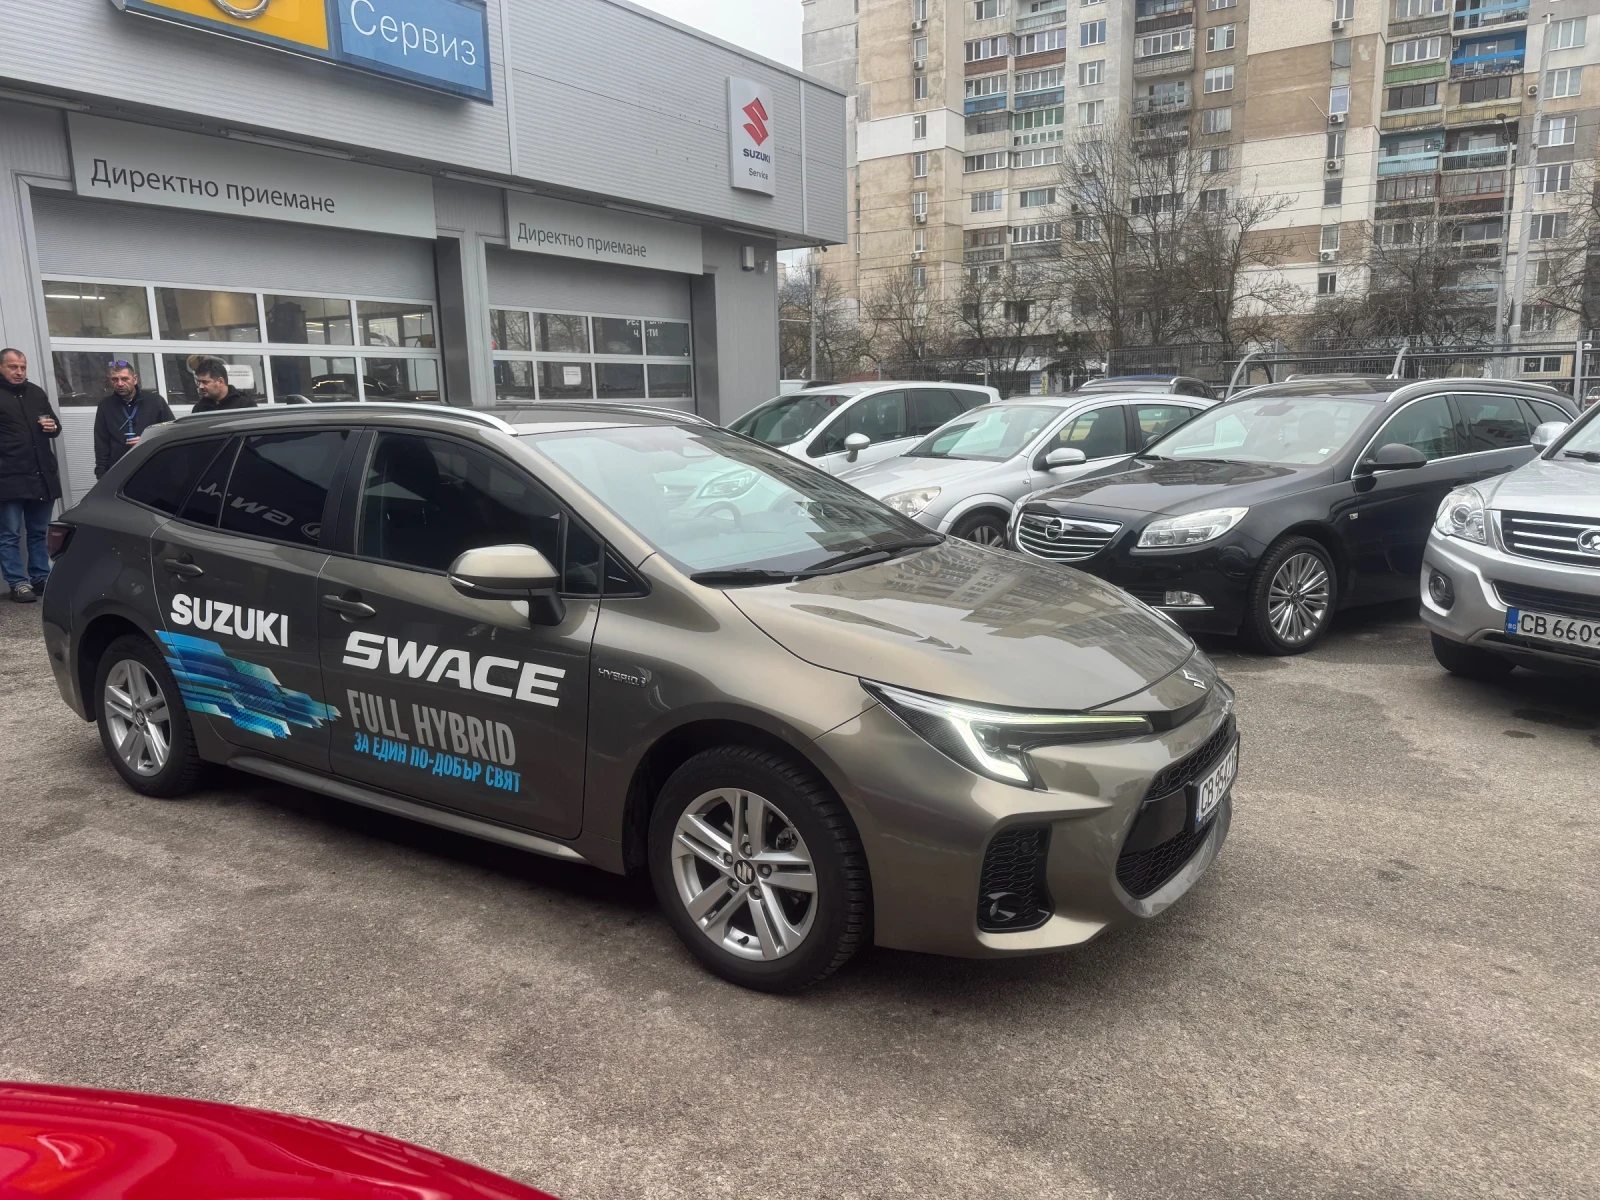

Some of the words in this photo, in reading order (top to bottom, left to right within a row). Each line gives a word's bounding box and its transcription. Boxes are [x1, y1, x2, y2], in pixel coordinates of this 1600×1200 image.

[350, 0, 476, 66] Сервиз
[743, 148, 771, 163] SUZUKI
[748, 167, 769, 180] Service
[91, 158, 219, 198] Директно
[226, 183, 336, 214] приемане
[517, 222, 584, 248] Директно
[587, 237, 647, 258] приемане
[170, 593, 289, 647] SUZUKI
[1521, 614, 1547, 635] CB
[342, 630, 567, 707] SWACE
[346, 688, 410, 741] FULL
[411, 703, 516, 766] HYBRID
[354, 731, 370, 754] ЗА
[372, 738, 407, 764] ЕДИН
[410, 746, 482, 782] ПО-ДОБЪР
[485, 764, 521, 793] СВЯТ
